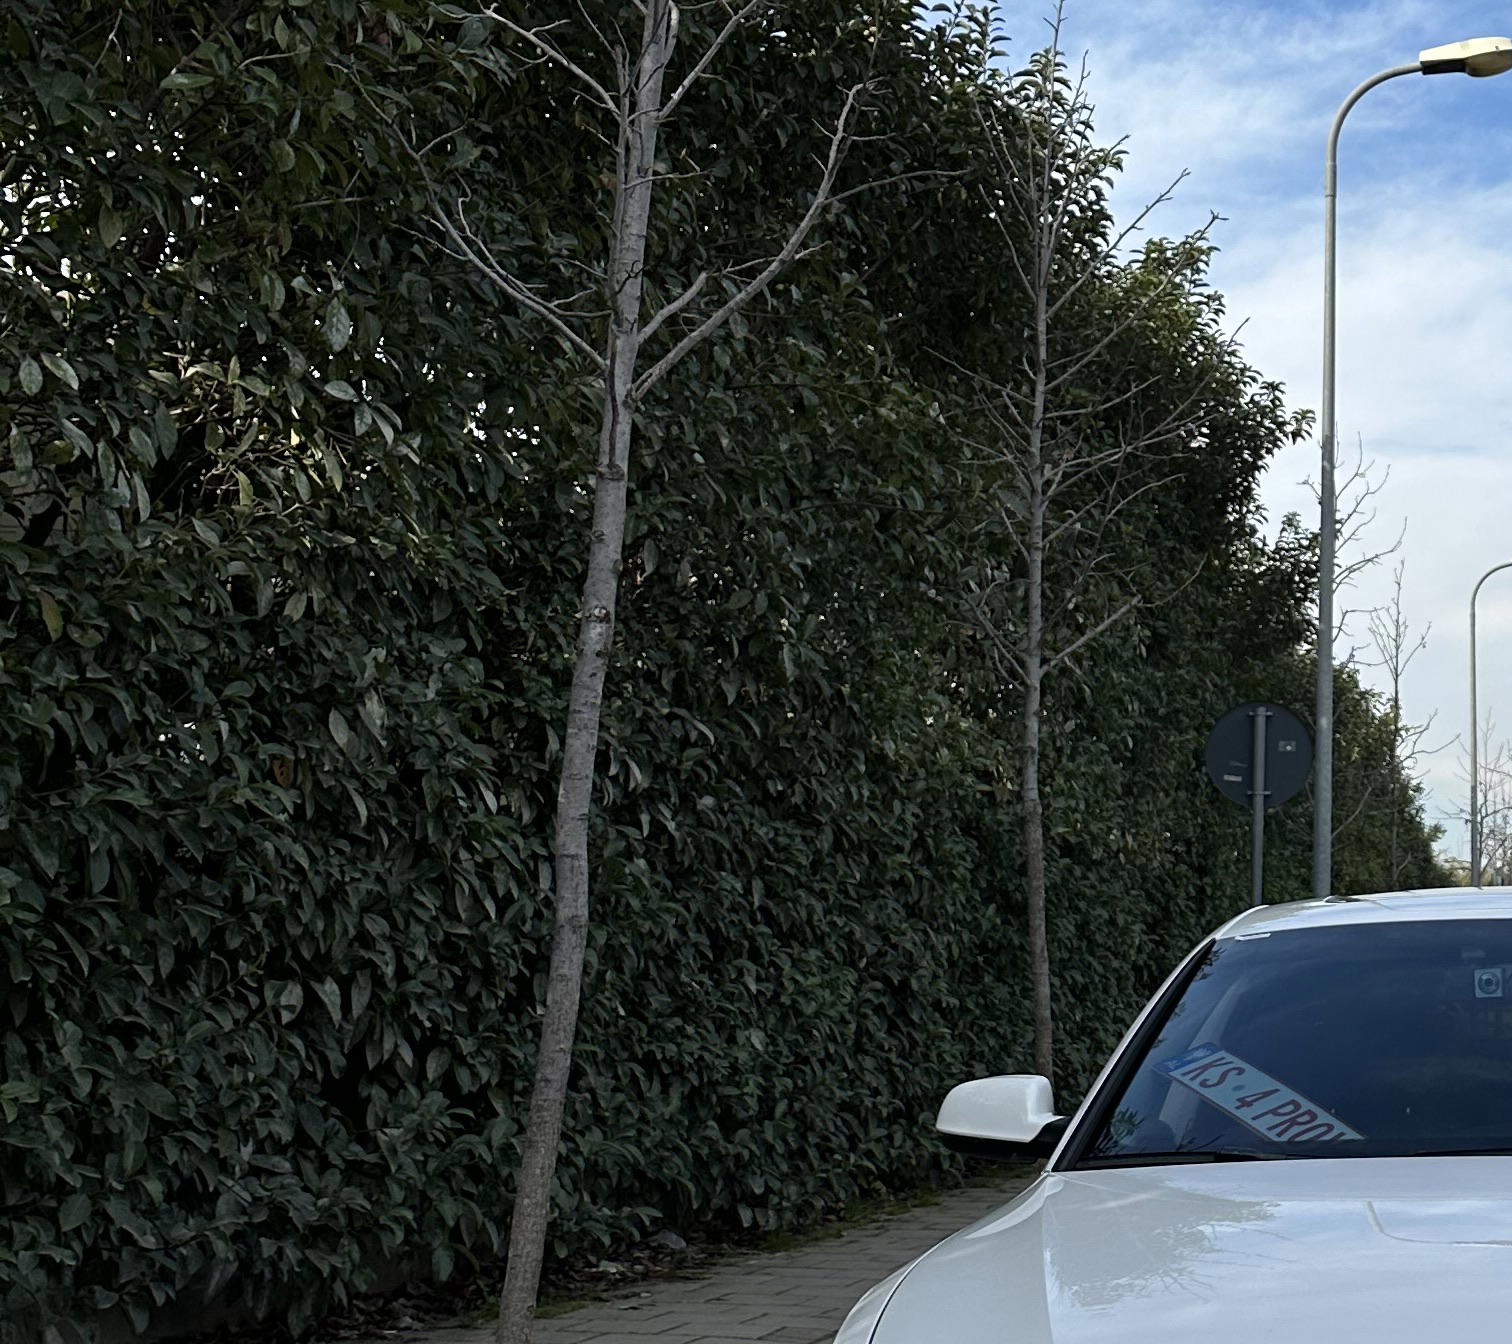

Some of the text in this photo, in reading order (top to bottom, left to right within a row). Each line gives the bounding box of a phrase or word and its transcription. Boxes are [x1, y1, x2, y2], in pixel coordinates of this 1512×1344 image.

[1181, 1057, 1347, 1142] KS 4 PRO
